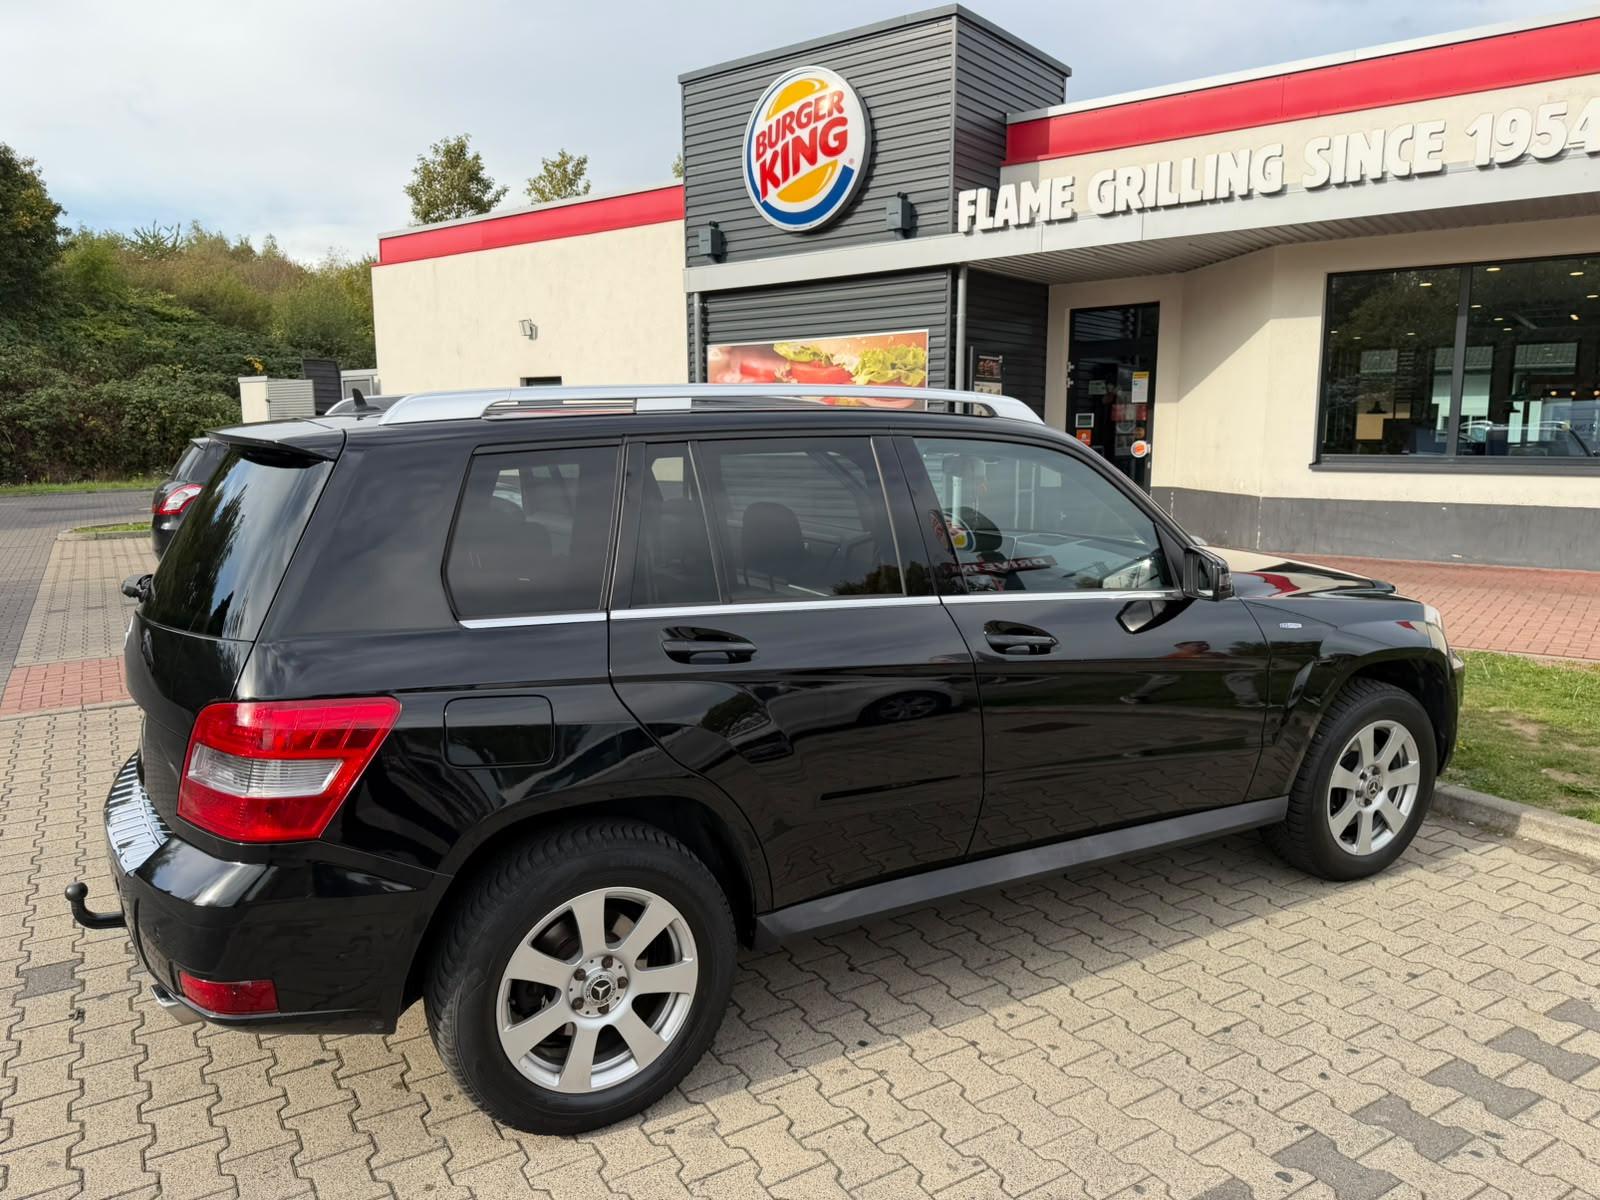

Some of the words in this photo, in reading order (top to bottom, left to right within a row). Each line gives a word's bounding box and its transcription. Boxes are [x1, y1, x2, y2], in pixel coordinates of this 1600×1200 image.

[756, 90, 845, 162] BURGER
[759, 116, 849, 200] KING
[957, 175, 1075, 233] FLAME
[1087, 143, 1284, 215] GRILLING
[1302, 119, 1446, 189] SINCE
[1464, 96, 1600, 168] 1954
